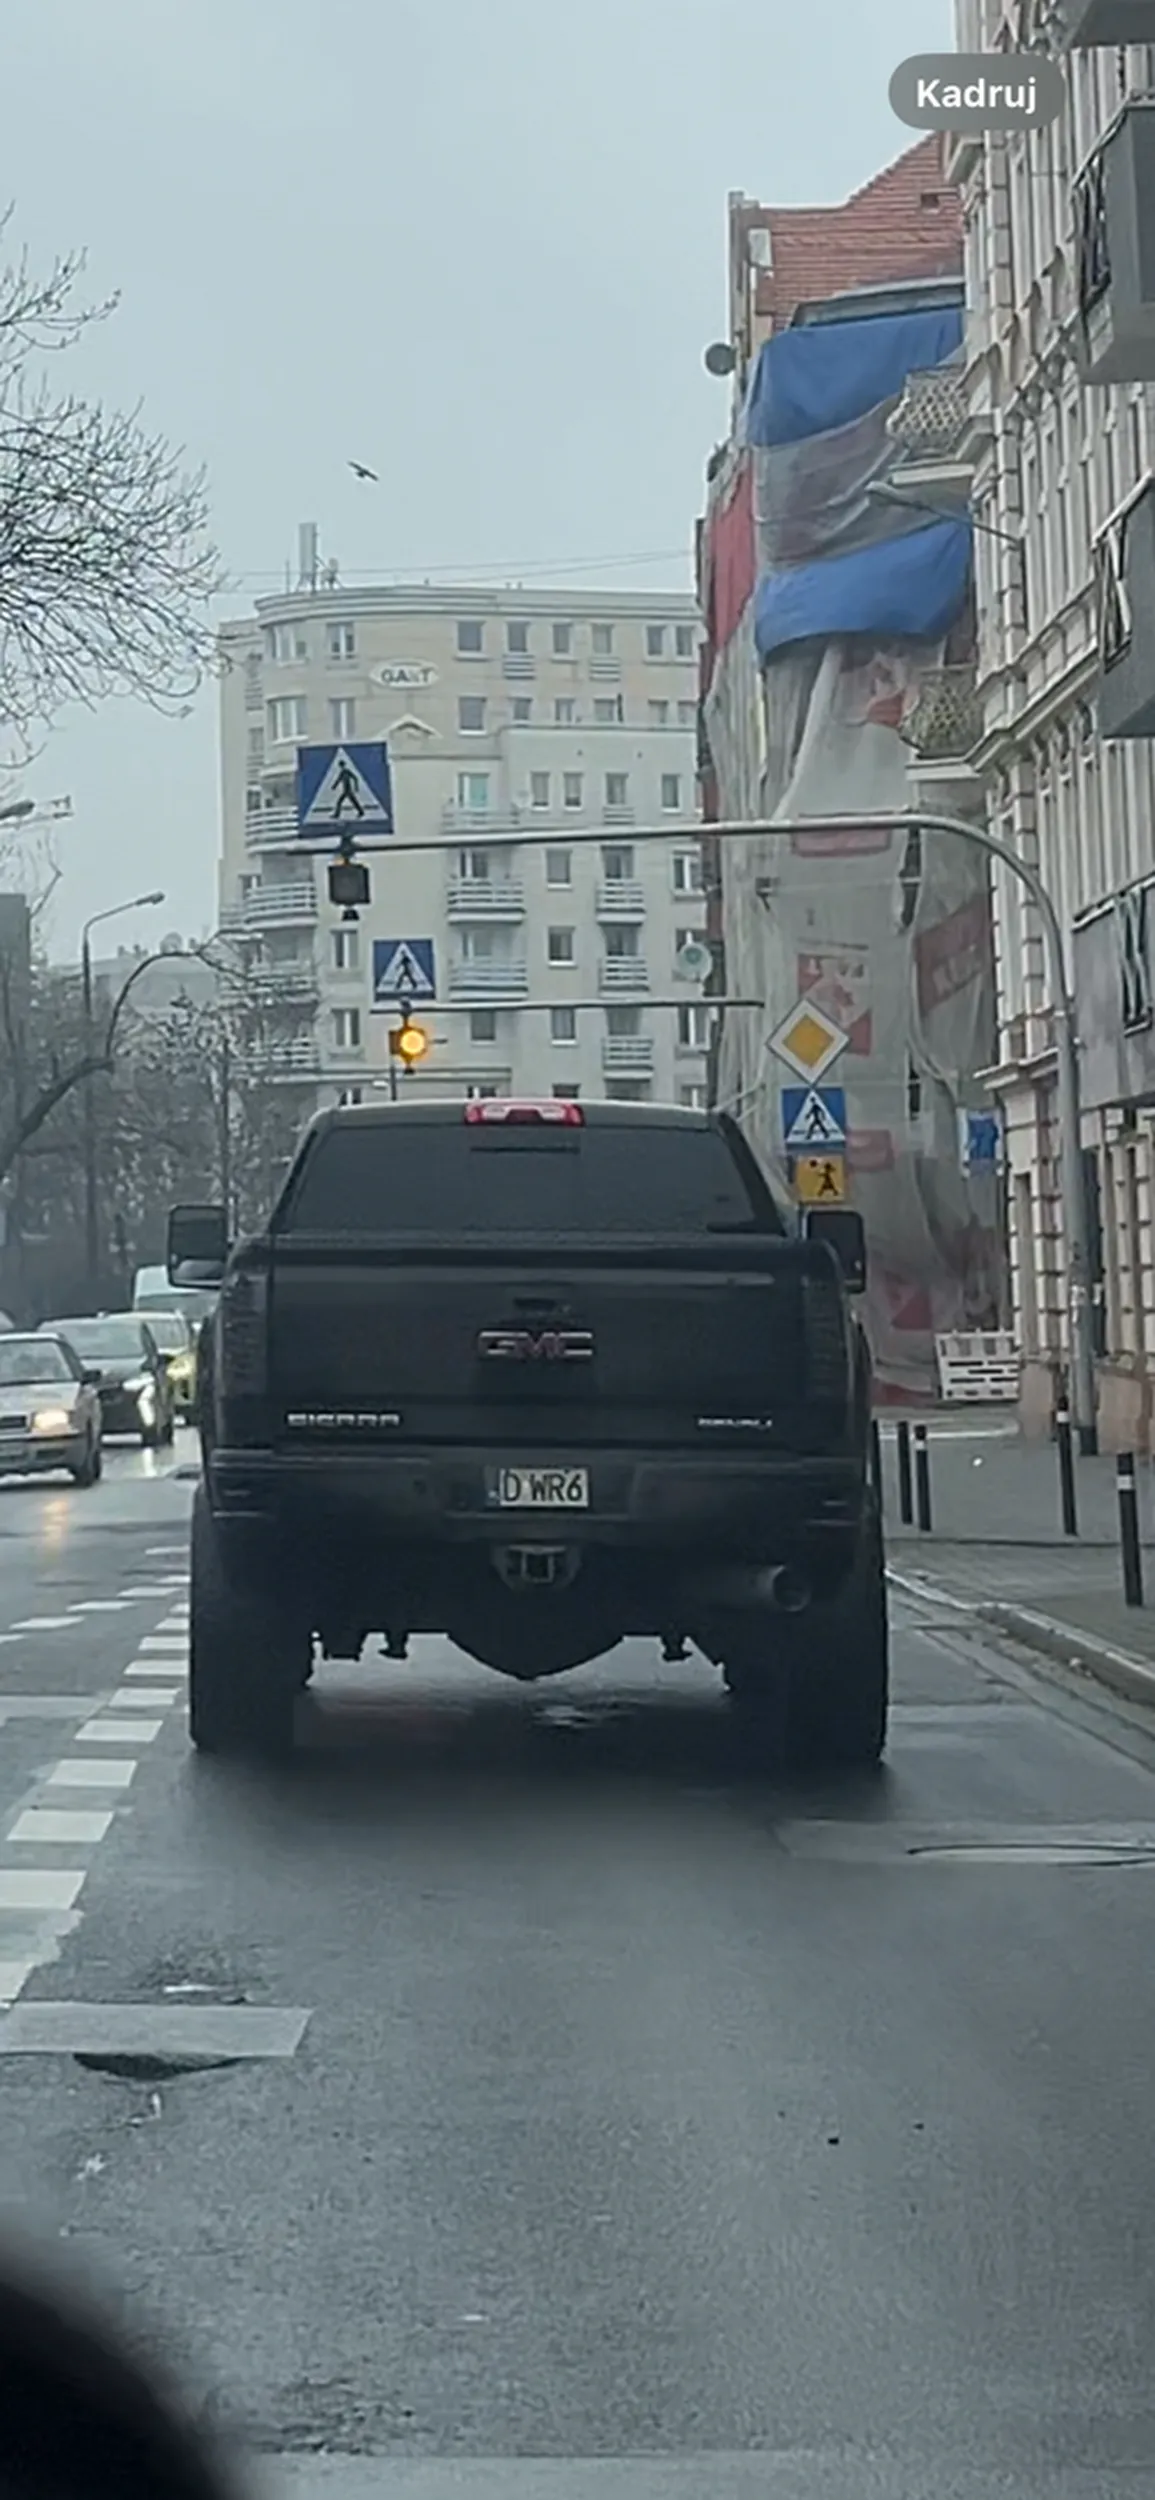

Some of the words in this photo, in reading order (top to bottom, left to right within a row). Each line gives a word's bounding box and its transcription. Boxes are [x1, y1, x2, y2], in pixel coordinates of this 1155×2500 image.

[479, 1331, 593, 1359] GMC
[504, 1470, 522, 1502] D
[529, 1473, 583, 1502] WR6
